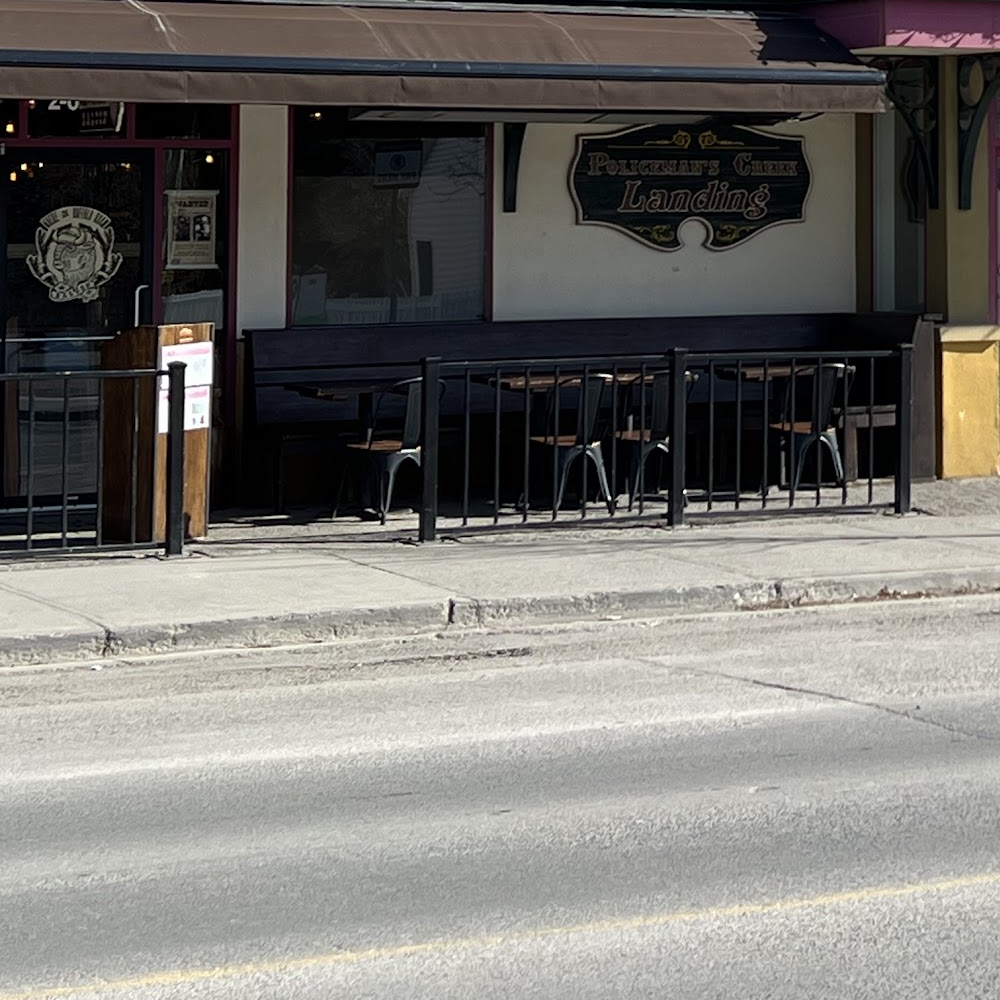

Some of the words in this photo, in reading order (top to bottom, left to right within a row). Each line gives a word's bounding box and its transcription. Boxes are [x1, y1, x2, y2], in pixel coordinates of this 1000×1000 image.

[587, 151, 720, 176] POLICEMAN'S
[733, 151, 799, 176] CREEK
[617, 180, 771, 220] Landing
